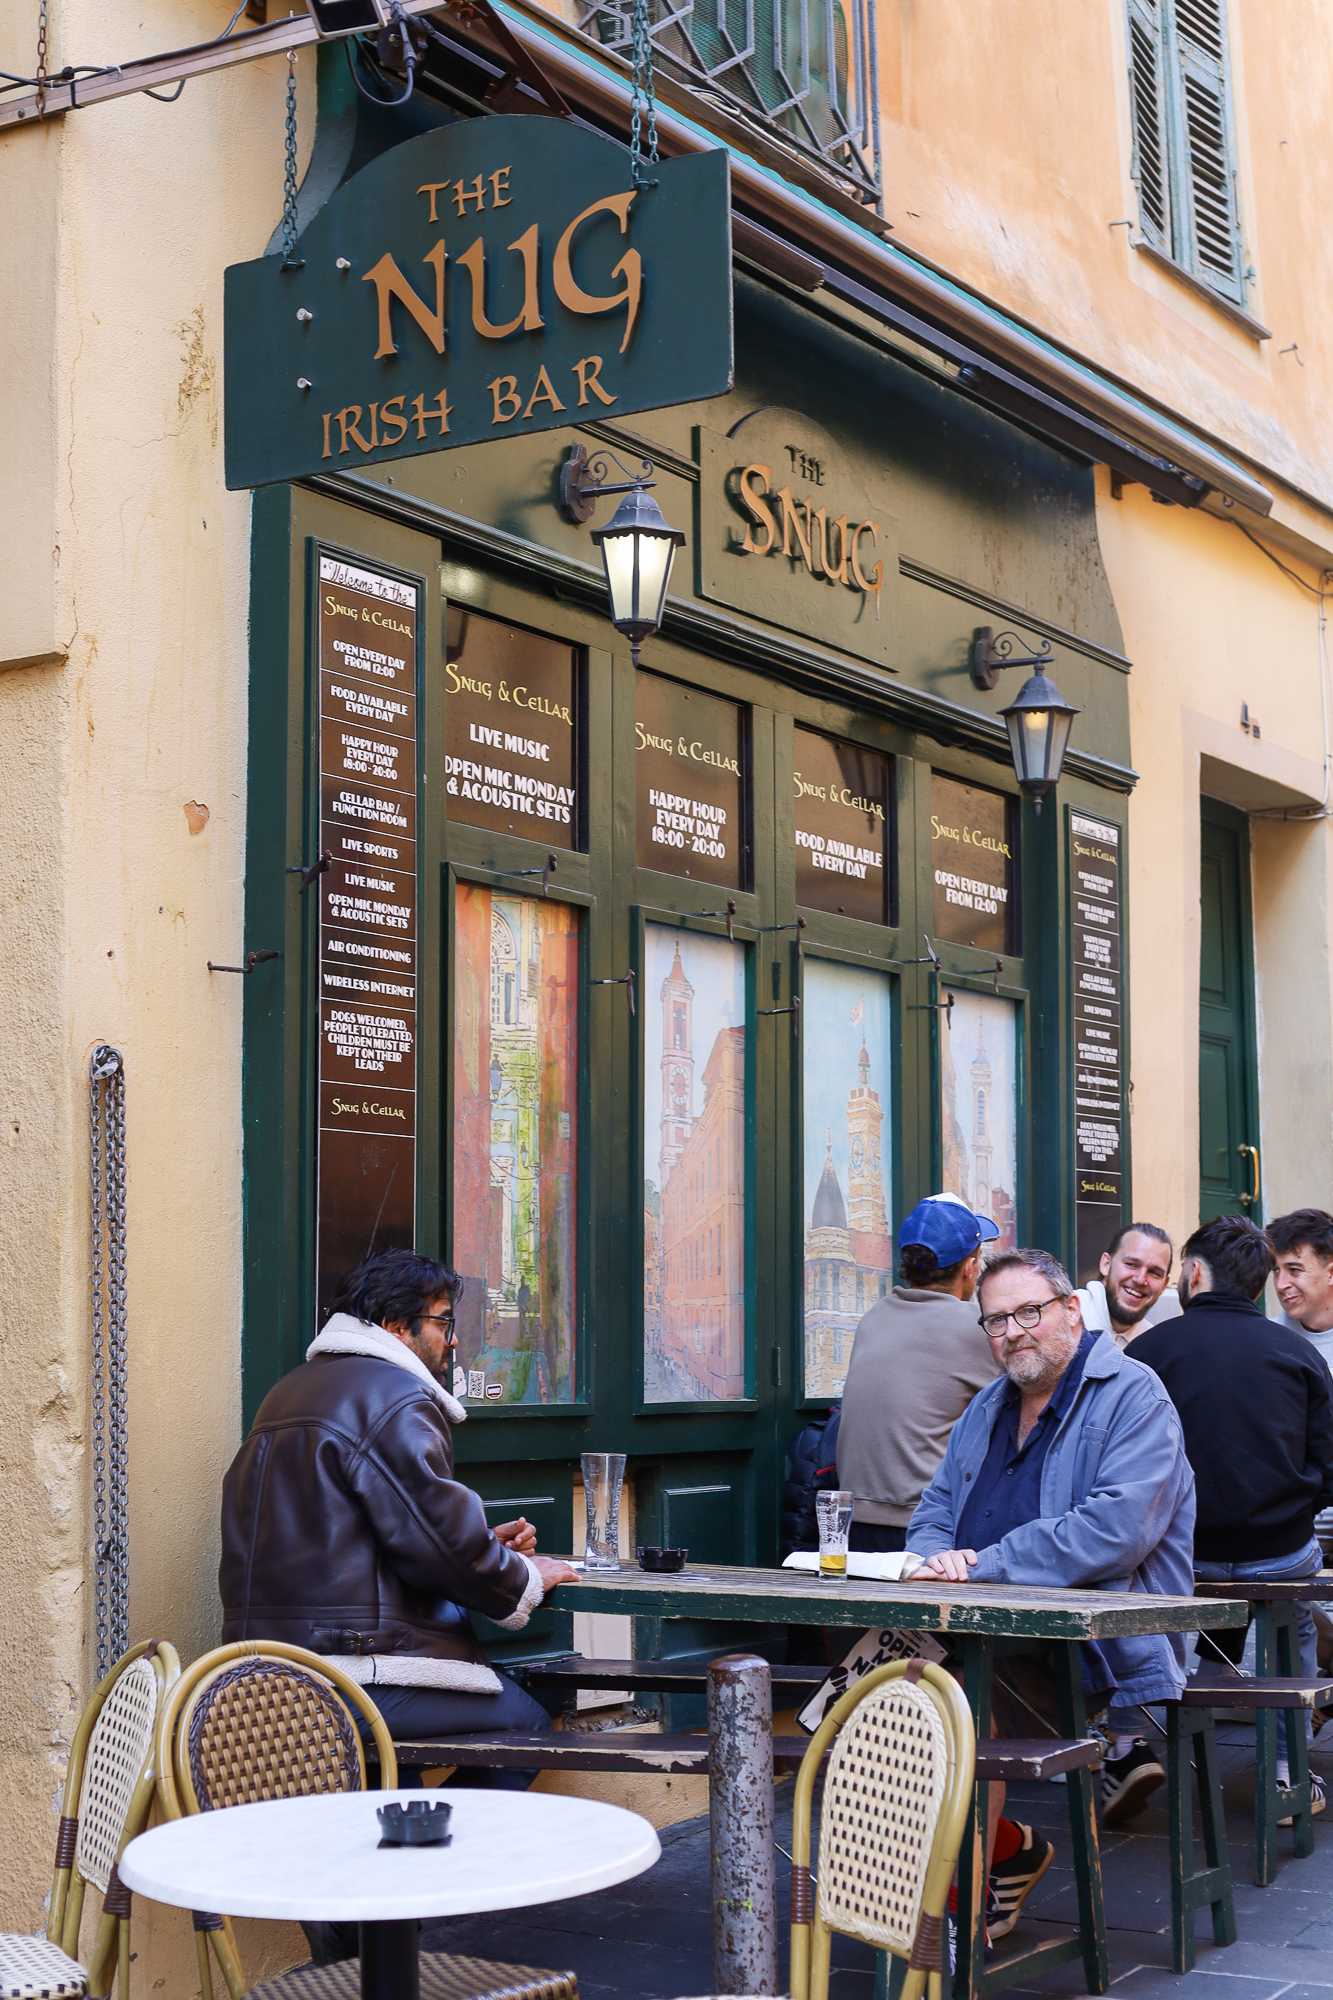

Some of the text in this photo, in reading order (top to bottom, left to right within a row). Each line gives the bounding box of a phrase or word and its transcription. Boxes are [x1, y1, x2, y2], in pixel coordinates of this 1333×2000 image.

[417, 166, 514, 223] THE
[362, 190, 642, 360] NUG
[321, 355, 617, 458] IRISH BAR
[783, 443, 826, 487] THE
[740, 463, 884, 621] SNUG
[361, 608, 371, 623] &
[332, 639, 406, 671] OPEN EVERY DAY
[344, 655, 396, 679] FROM 12:00
[330, 685, 409, 716] FOOD AVAILABLE
[498, 680, 511, 703] &
[345, 701, 395, 723] EVERY DAY
[341, 733, 399, 758] HAPPY HOUR
[469, 722, 550, 762] LIVE MUSIC
[677, 736, 689, 757] &
[343, 757, 367, 773] 18:00
[372, 764, 398, 781] 20:00
[347, 747, 394, 768] EVERY DAY
[484, 765, 513, 790] MIC
[514, 774, 576, 806] MONDAY
[829, 784, 840, 803] &
[339, 791, 375, 808] CELLAR
[376, 798, 395, 813] BAR
[446, 776, 571, 824] & ACOUSTIC SETS
[649, 788, 727, 825] HAPPY HOUR
[332, 801, 407, 828] FUNCTION ROOM
[656, 809, 721, 840] EVERY DAY
[651, 825, 685, 849] 18:00
[692, 836, 726, 859] 20:00
[962, 826, 971, 844] &
[341, 837, 399, 860] LIVE SPORTS
[795, 829, 883, 868] FOOD AVAILABLE
[811, 851, 867, 880] EVERY DAY
[344, 872, 396, 893] LIVE MUSIC
[934, 869, 1008, 902] OPEN EVERY DAY
[328, 893, 411, 919] OPEN MIC MONDAY
[946, 887, 998, 915] FROM 12:00
[331, 905, 409, 930] & ACOUSTIC SETS
[327, 939, 412, 964] AIR CONDITIONING
[323, 974, 415, 998] WIRELESS INTERNET
[324, 1020, 360, 1034] PEOPLE
[330, 1009, 356, 1024] DOGS
[327, 1033, 411, 1053] CHILDREN MUST BE
[336, 1044, 402, 1063] KEPT ON THEIR
[355, 1058, 384, 1072] LEADS
[361, 1101, 370, 1114] &
